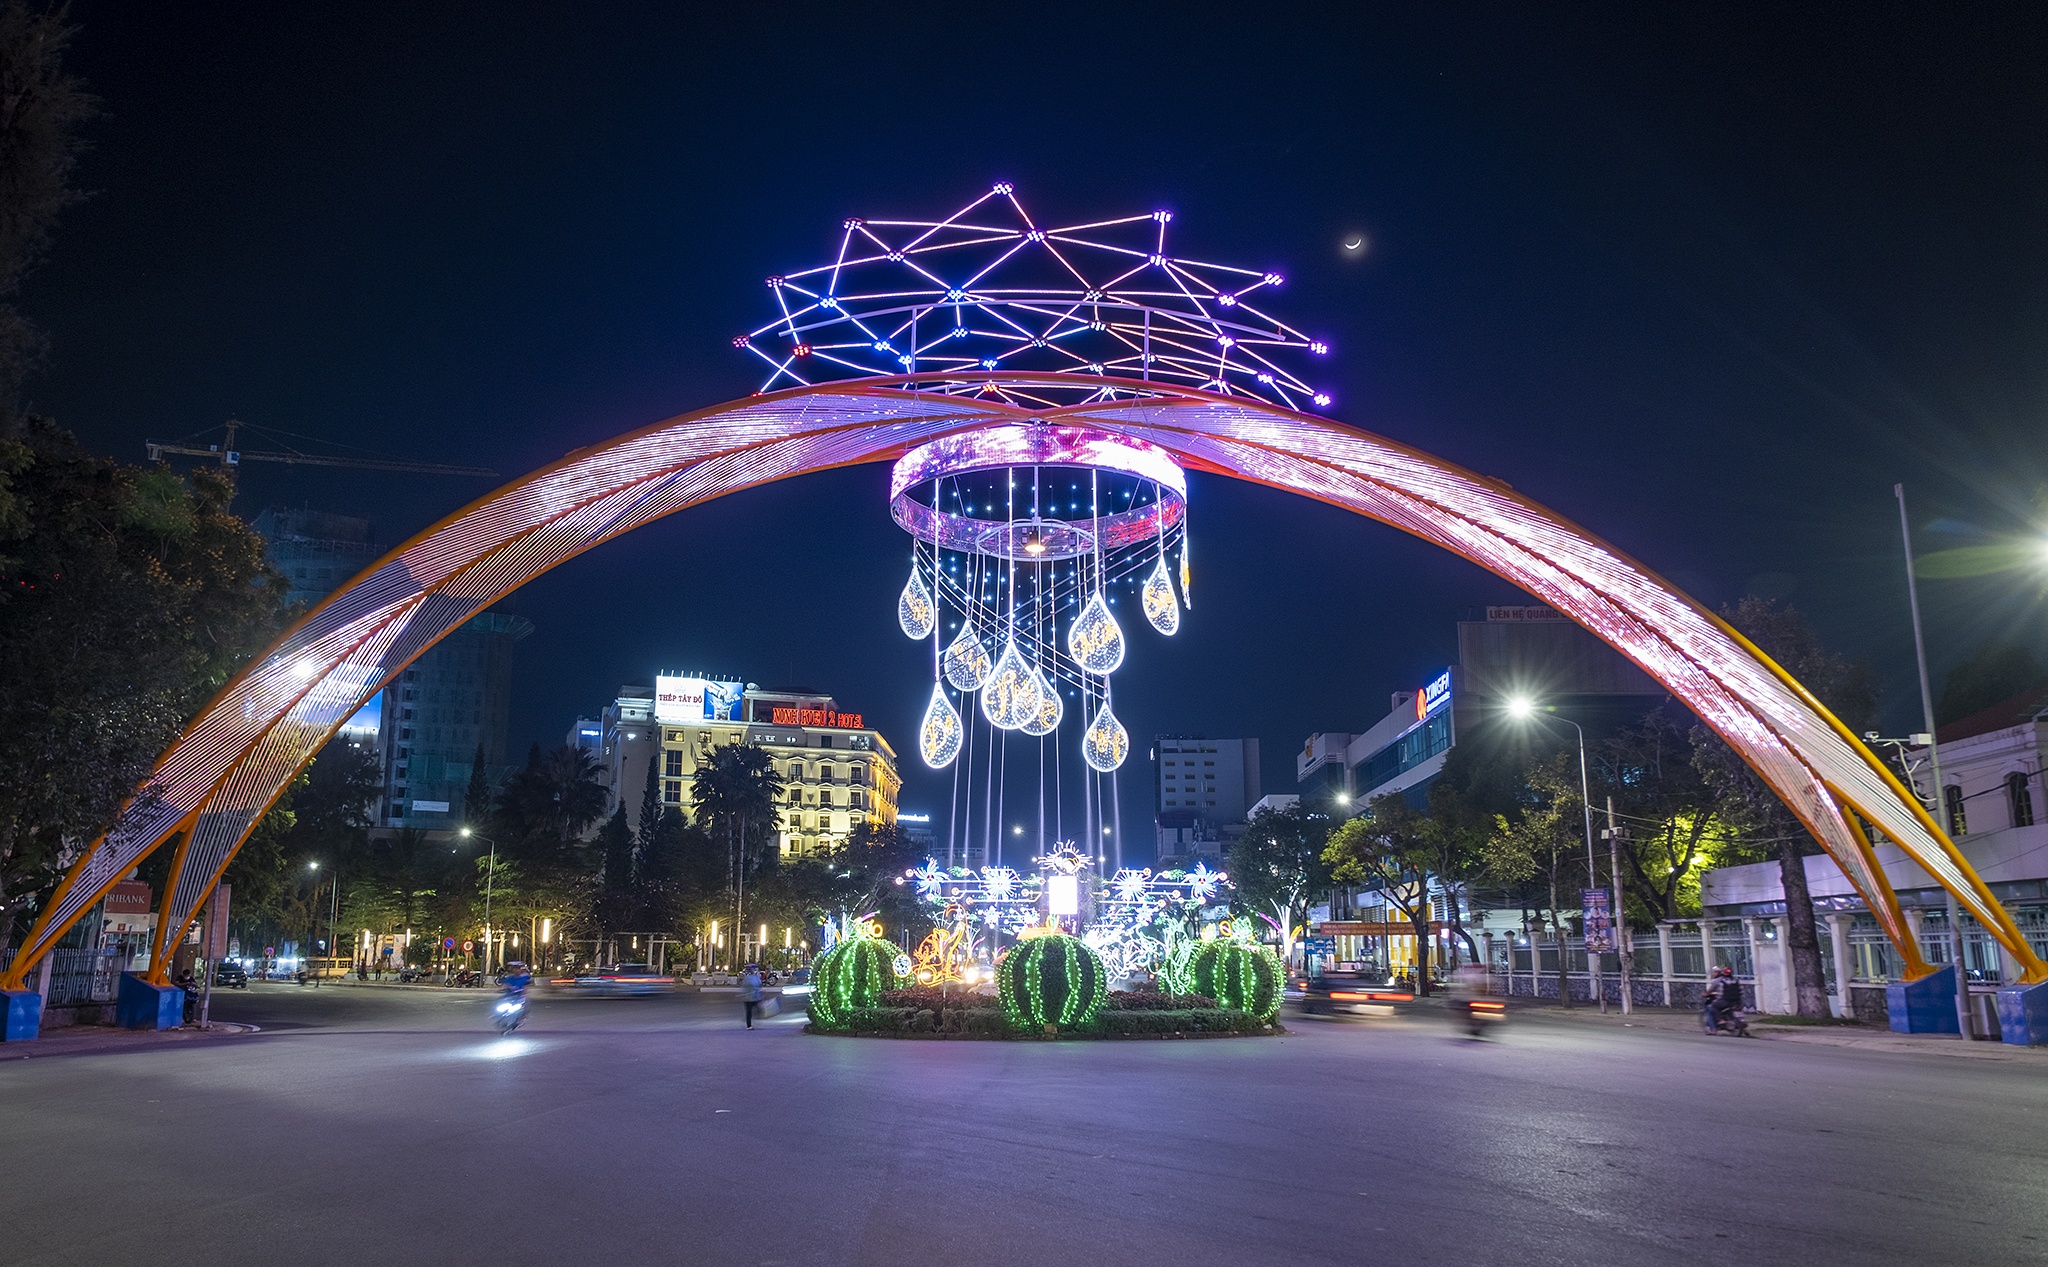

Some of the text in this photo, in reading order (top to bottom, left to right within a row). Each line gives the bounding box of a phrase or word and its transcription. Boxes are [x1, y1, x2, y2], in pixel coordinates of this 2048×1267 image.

[659, 693, 677, 702] THÉP
[678, 694, 692, 703] TÂY
[772, 707, 799, 725] NINH
[828, 710, 836, 727] 2
[837, 713, 865, 729] HOTEL
